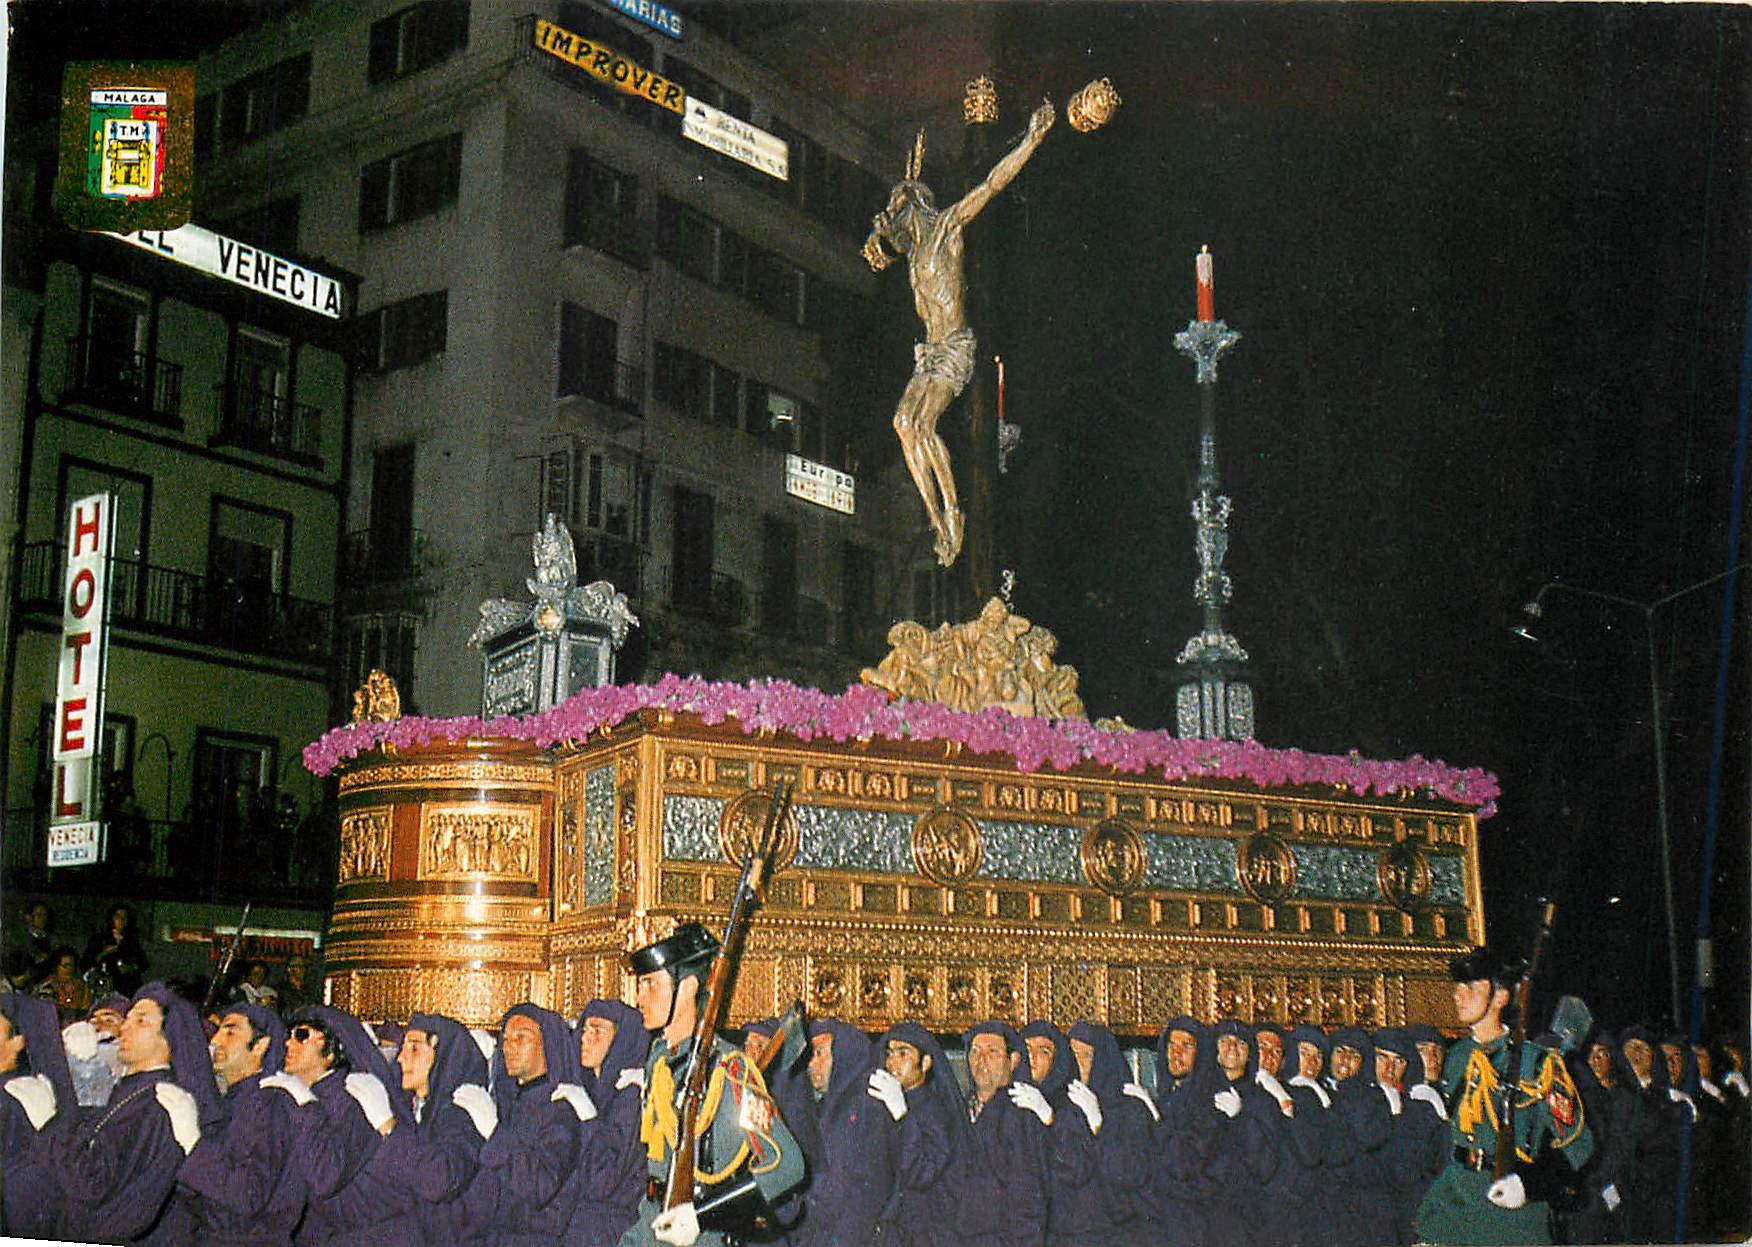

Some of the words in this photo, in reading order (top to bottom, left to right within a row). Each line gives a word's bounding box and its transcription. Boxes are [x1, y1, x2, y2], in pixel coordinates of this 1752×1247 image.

[619, 0, 682, 35] ARIAS
[541, 26, 685, 108] IMPROVER
[215, 235, 340, 315] VENECIA
[801, 460, 853, 488] Eurpa
[57, 501, 100, 816] HOTEL
[49, 826, 94, 848] VENECIA
